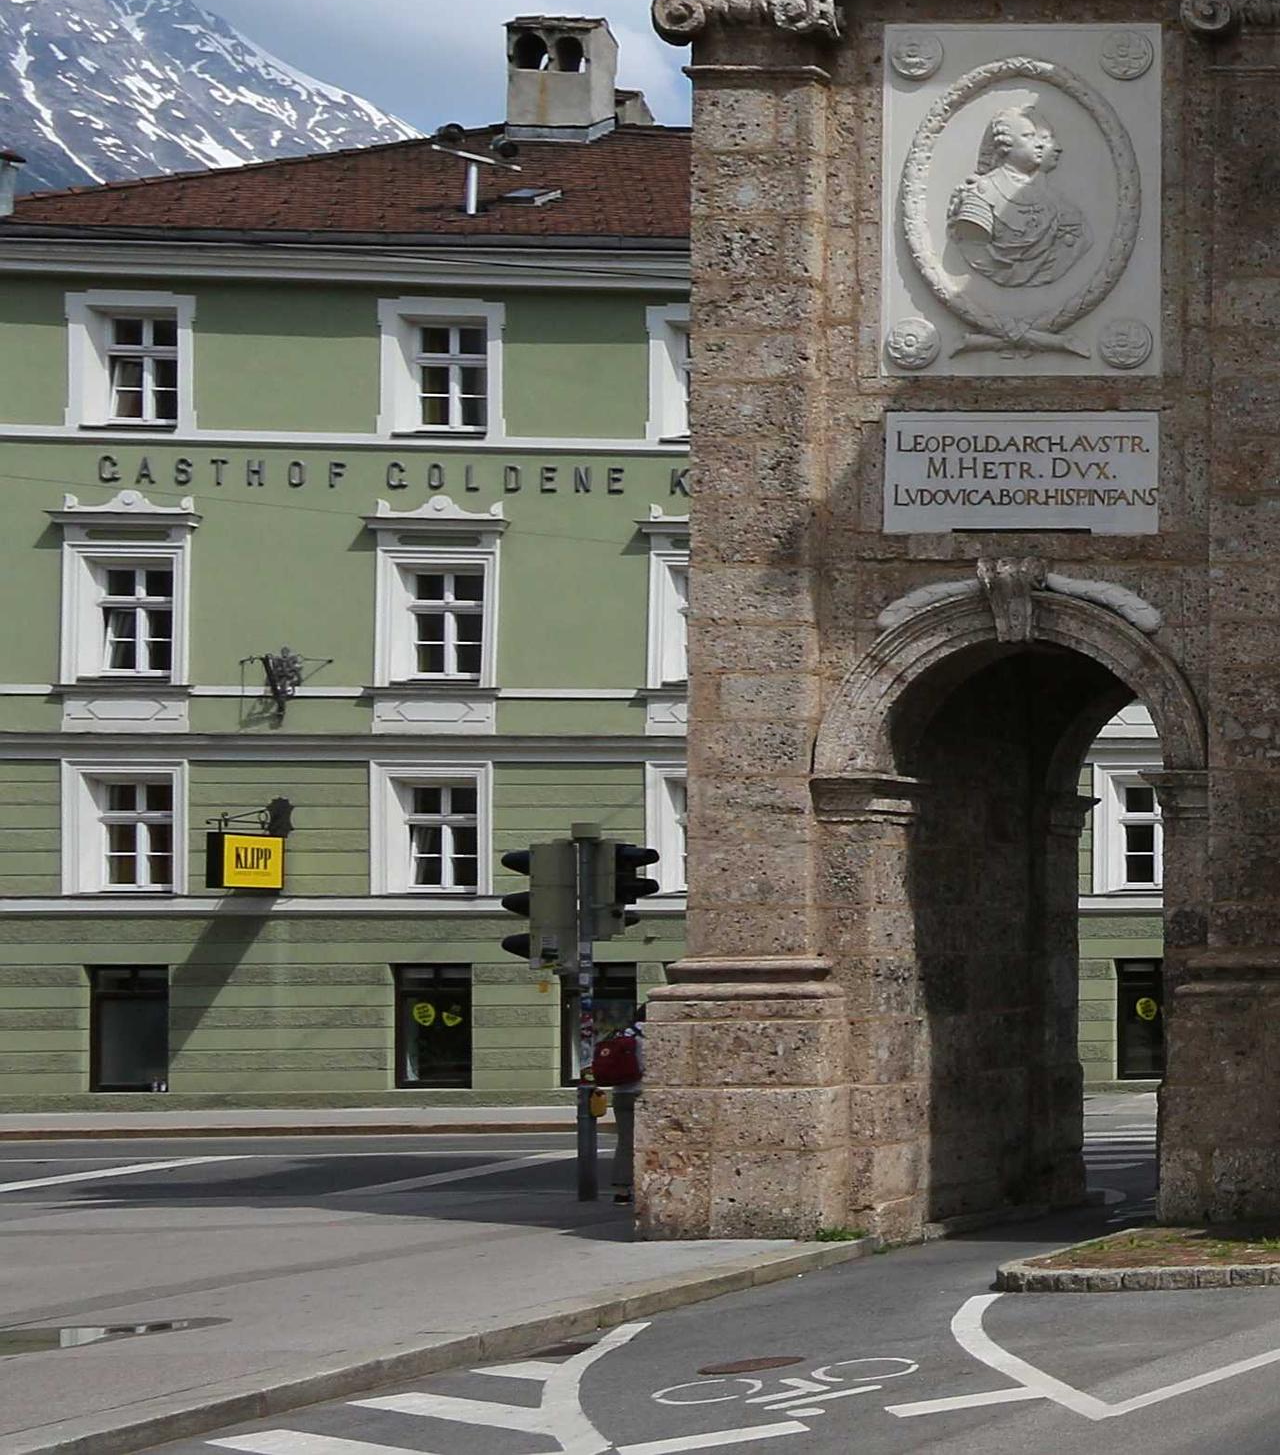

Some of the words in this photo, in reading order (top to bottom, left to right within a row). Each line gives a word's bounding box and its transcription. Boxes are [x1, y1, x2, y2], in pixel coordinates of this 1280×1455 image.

[98, 455, 347, 489] GASTHOF
[386, 460, 625, 495] GOLDENE
[234, 846, 272, 870] KLIPP
